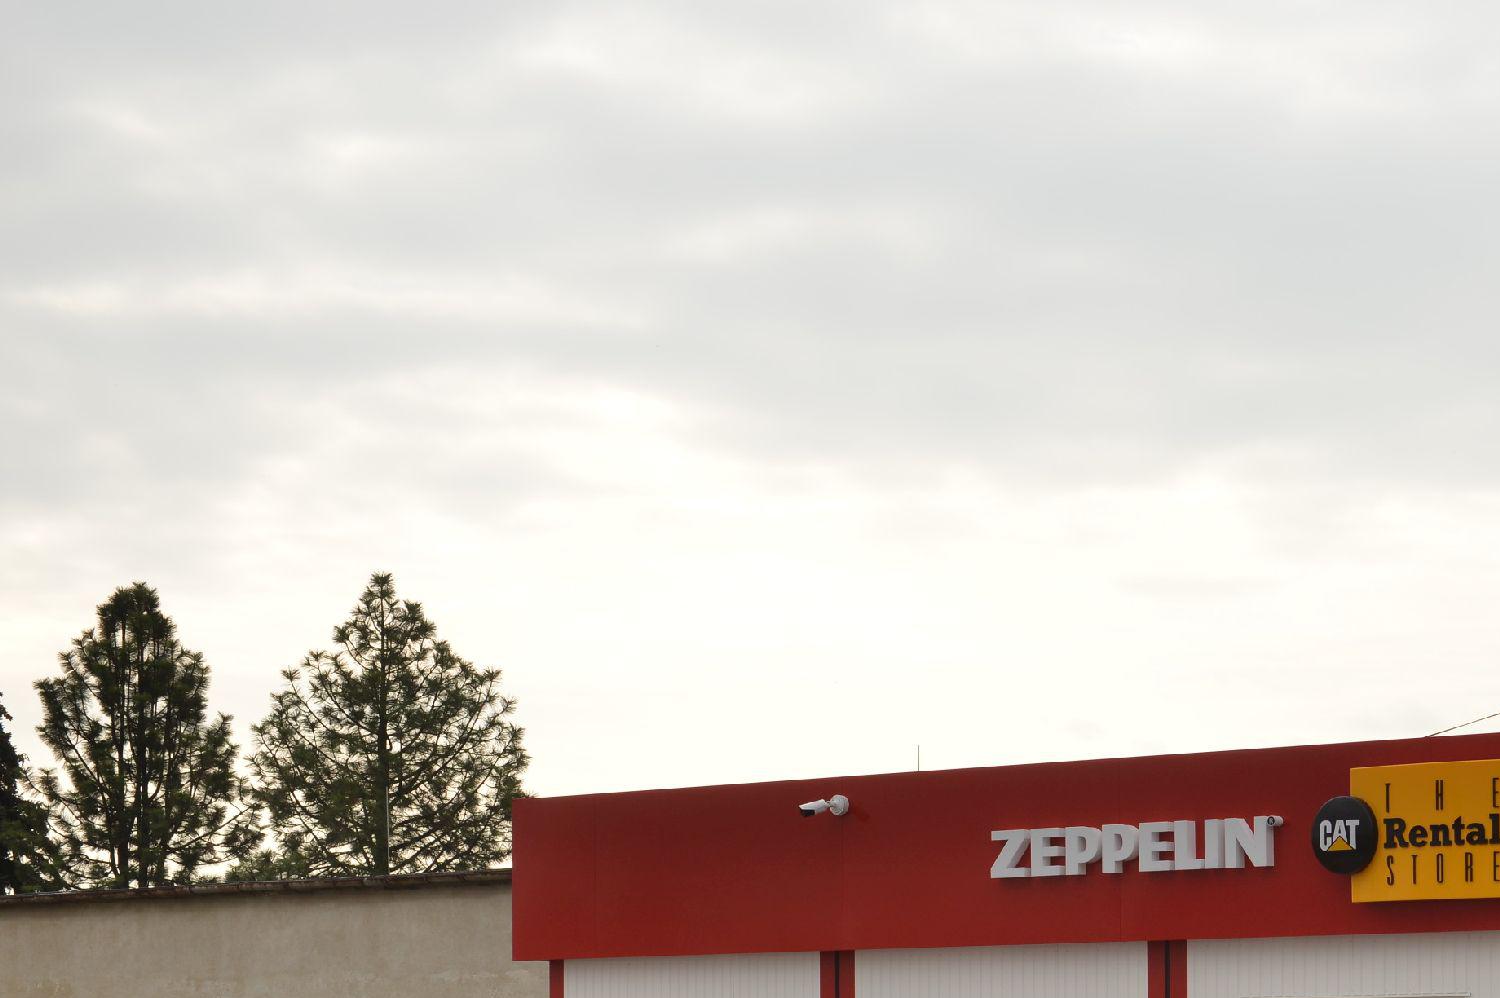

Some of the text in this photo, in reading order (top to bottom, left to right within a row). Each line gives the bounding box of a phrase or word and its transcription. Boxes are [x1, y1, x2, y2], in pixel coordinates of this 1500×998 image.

[1384, 777, 1500, 813] THE
[990, 815, 1275, 879] ZEPPELIN
[1319, 819, 1360, 852] CAT
